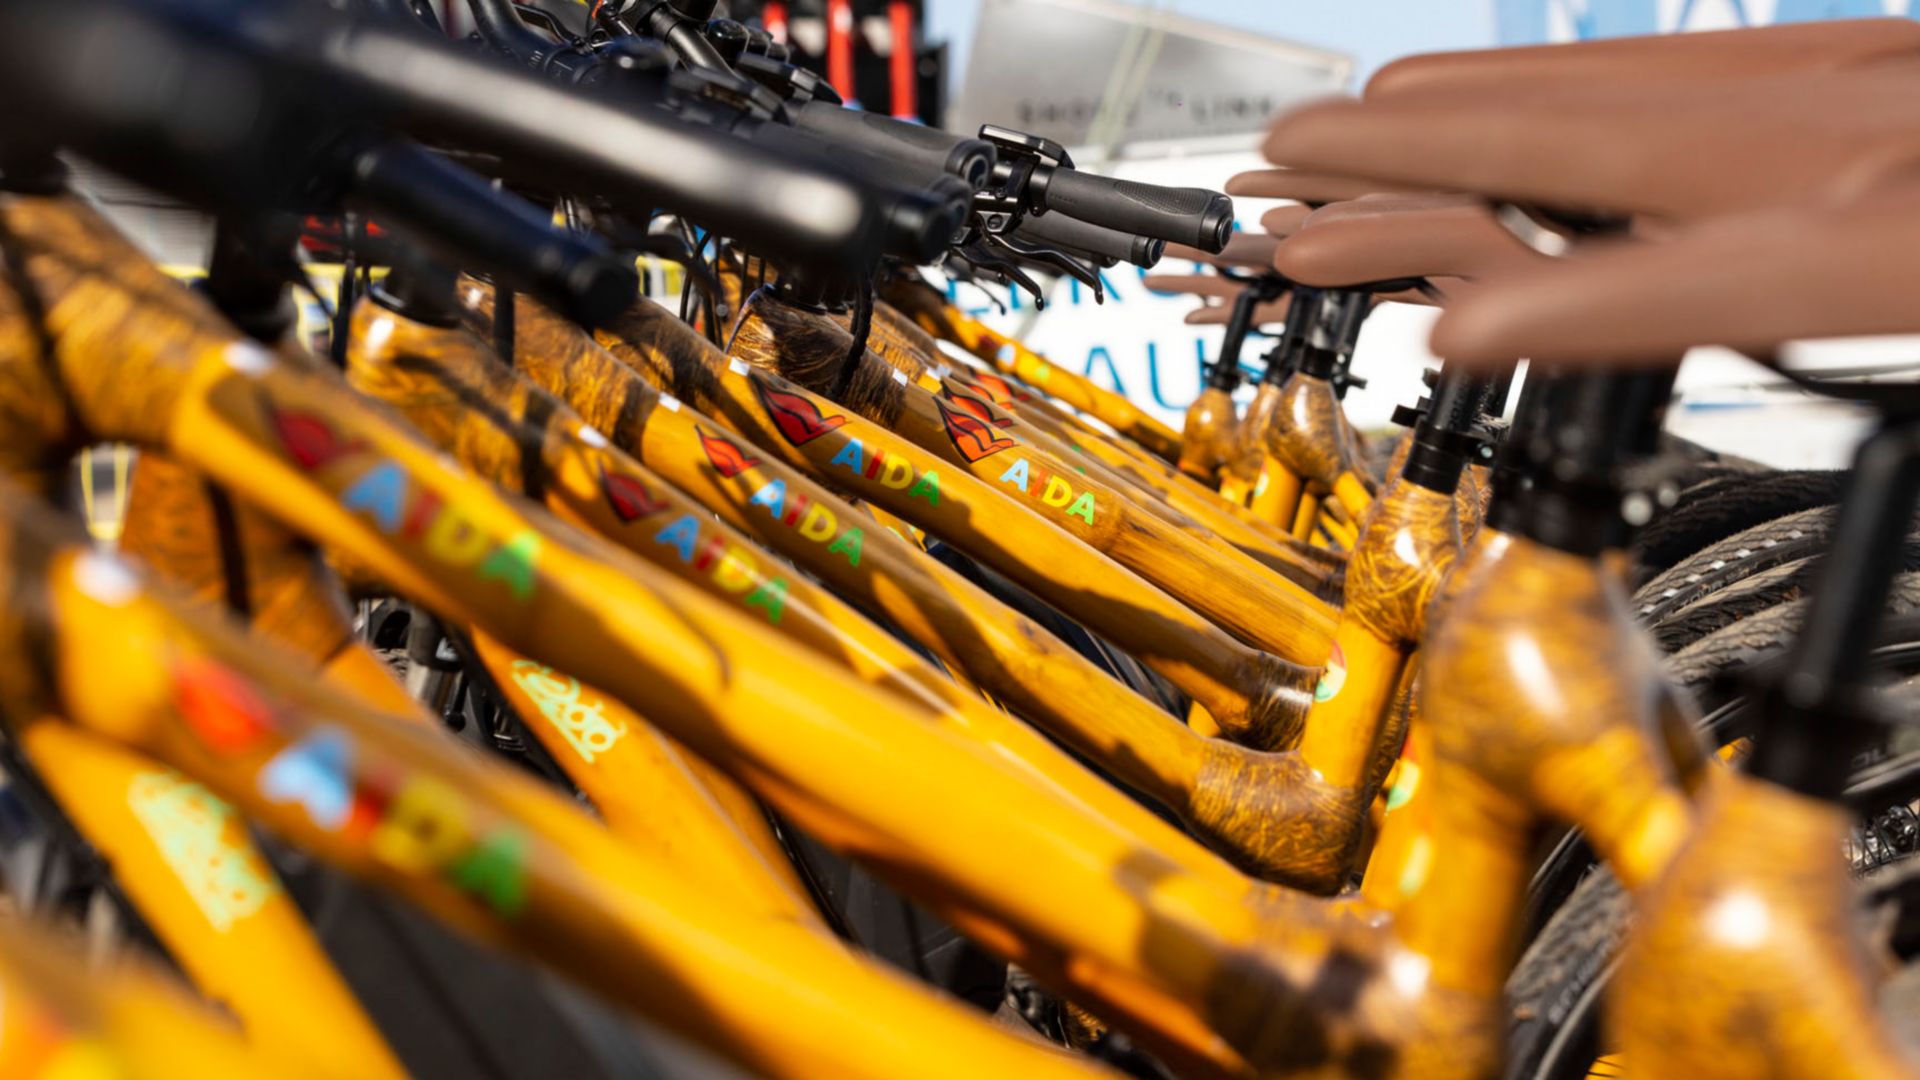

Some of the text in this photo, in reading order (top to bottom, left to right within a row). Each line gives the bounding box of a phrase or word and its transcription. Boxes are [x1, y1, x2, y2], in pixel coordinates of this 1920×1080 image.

[832, 438, 940, 507] AIDA
[999, 458, 1096, 526] AIDA
[340, 460, 542, 602] AIDA
[751, 478, 865, 567] AIDA
[654, 514, 790, 624] AIDA
